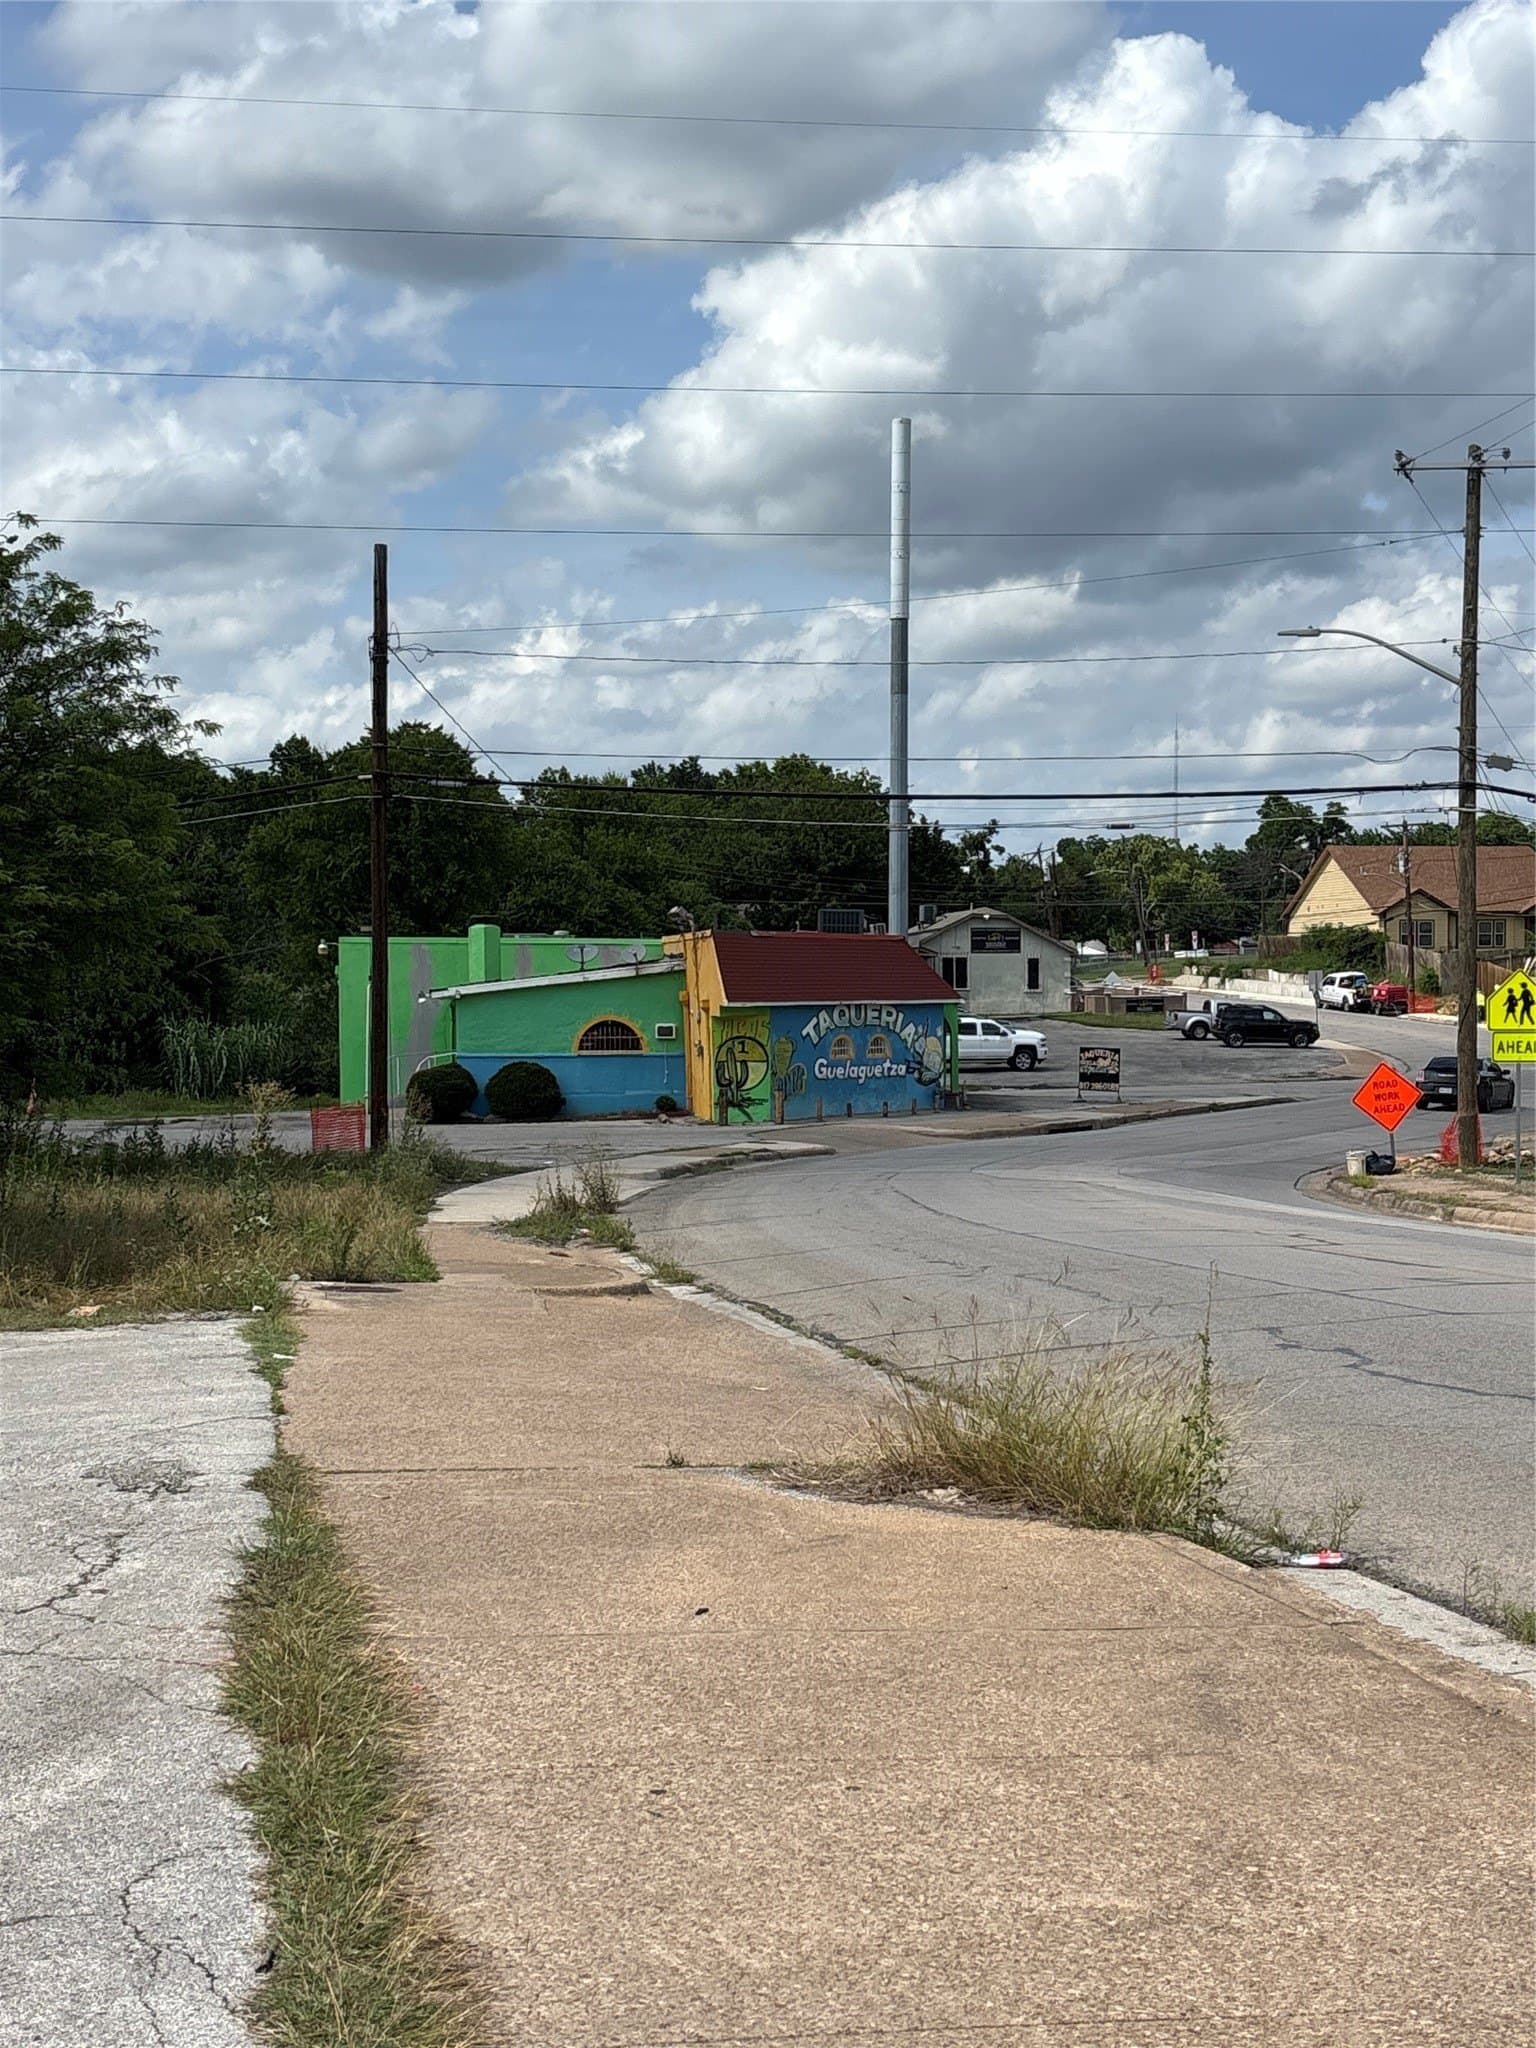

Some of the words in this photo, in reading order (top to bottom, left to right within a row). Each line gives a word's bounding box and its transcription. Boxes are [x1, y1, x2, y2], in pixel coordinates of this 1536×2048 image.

[802, 1004, 916, 1049] TAQUERIA
[1496, 1040, 1536, 1054] AHEA
[814, 1058, 907, 1085] Guelaguetza
[1372, 1079, 1399, 1091] ROAD
[1373, 1091, 1401, 1101] WORK
[1373, 1102, 1406, 1115] AHEAD
